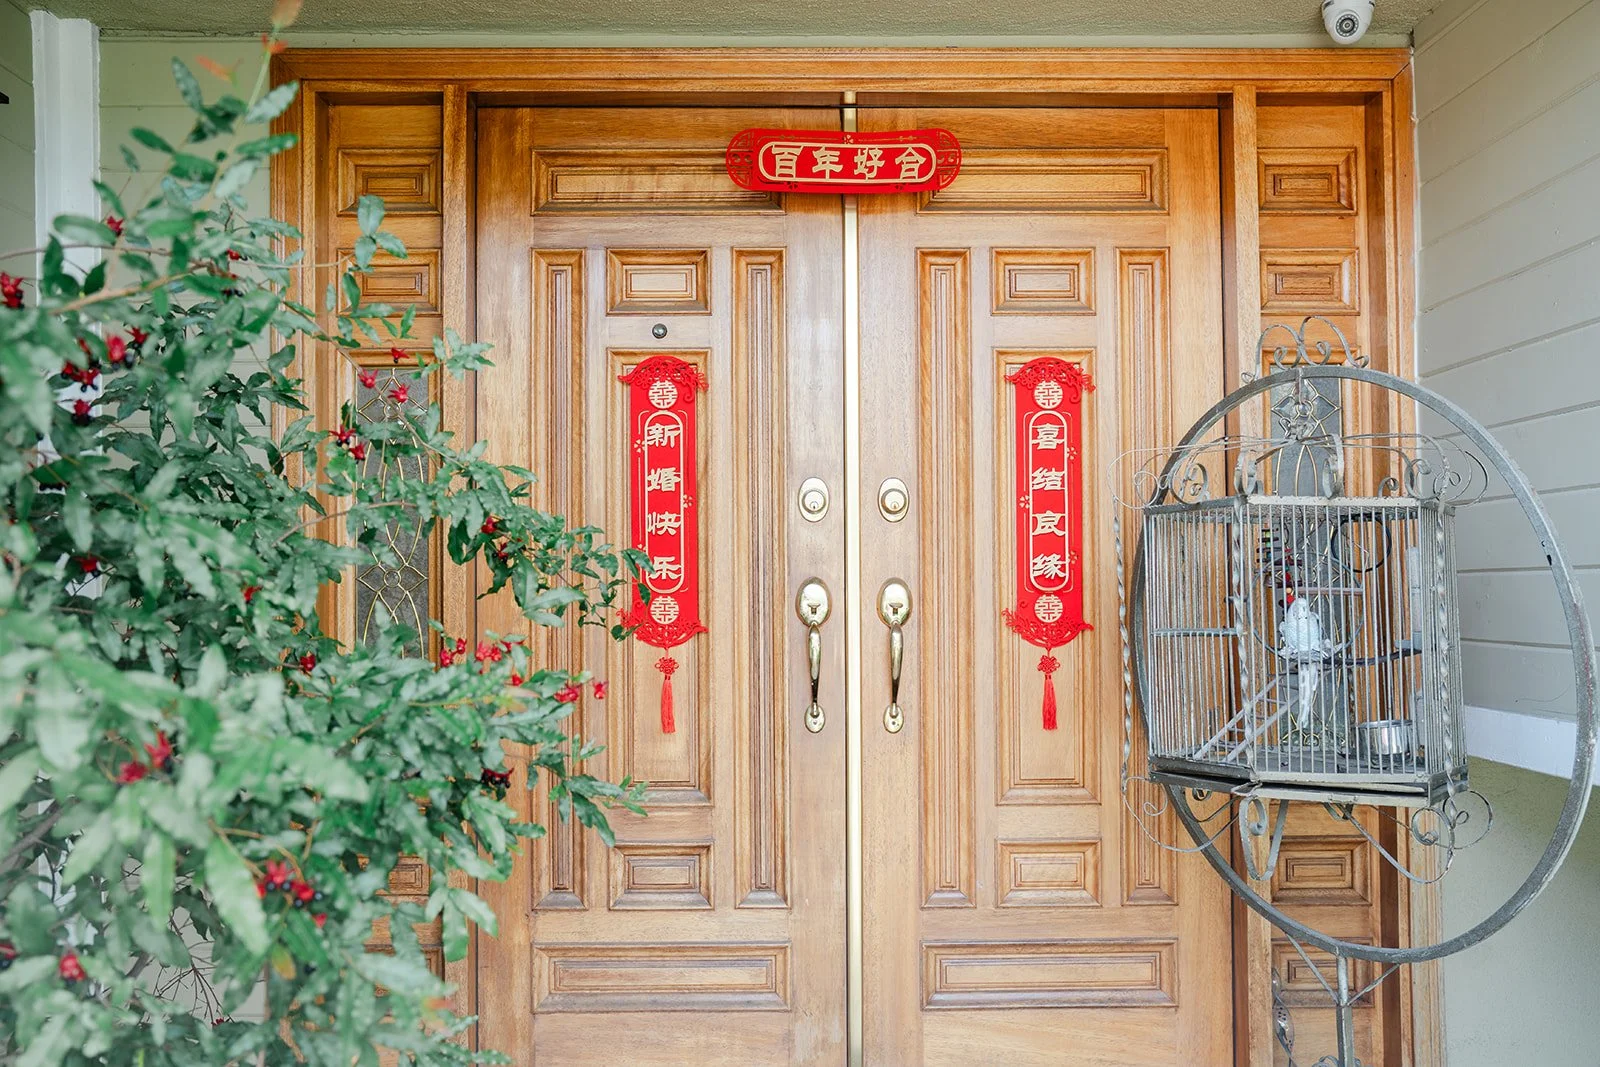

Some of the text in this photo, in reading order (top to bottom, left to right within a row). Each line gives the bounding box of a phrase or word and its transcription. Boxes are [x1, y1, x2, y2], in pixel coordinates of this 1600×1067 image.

[772, 144, 926, 180] 百年好合
[646, 423, 682, 580] 新婚快乐
[1032, 423, 1065, 579] 喜结良缘
